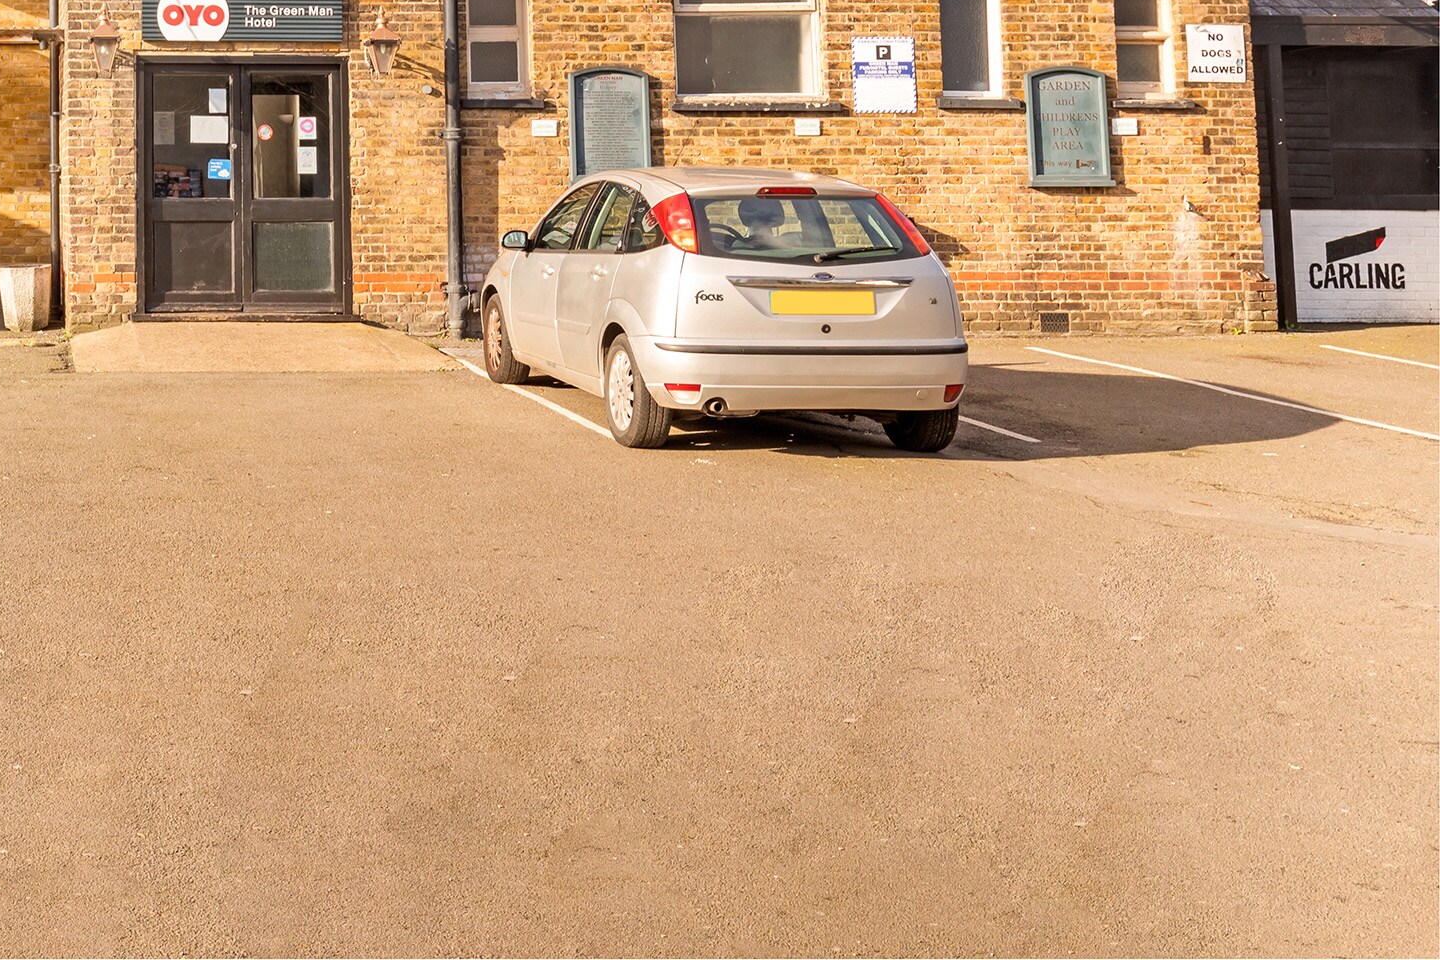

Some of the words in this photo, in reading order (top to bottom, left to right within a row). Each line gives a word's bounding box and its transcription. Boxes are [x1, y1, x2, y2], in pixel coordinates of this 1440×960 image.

[162, 4, 225, 27] OYO
[244, 5, 266, 16] The
[269, 5, 306, 16] Green
[308, 5, 334, 16] Man
[244, 17, 277, 28] Hotel
[1208, 33, 1224, 41] NO
[1201, 49, 1232, 57] DOGS
[1191, 65, 1244, 74] ALLOWED
[1038, 81, 1091, 91] GARDEN
[1055, 96, 1075, 106] and
[1034, 112, 1099, 122] CHILDRENS
[1052, 127, 1081, 136] PLAY
[1052, 141, 1084, 150] AREA
[1057, 160, 1073, 168] way
[1309, 263, 1405, 289] CARLING
